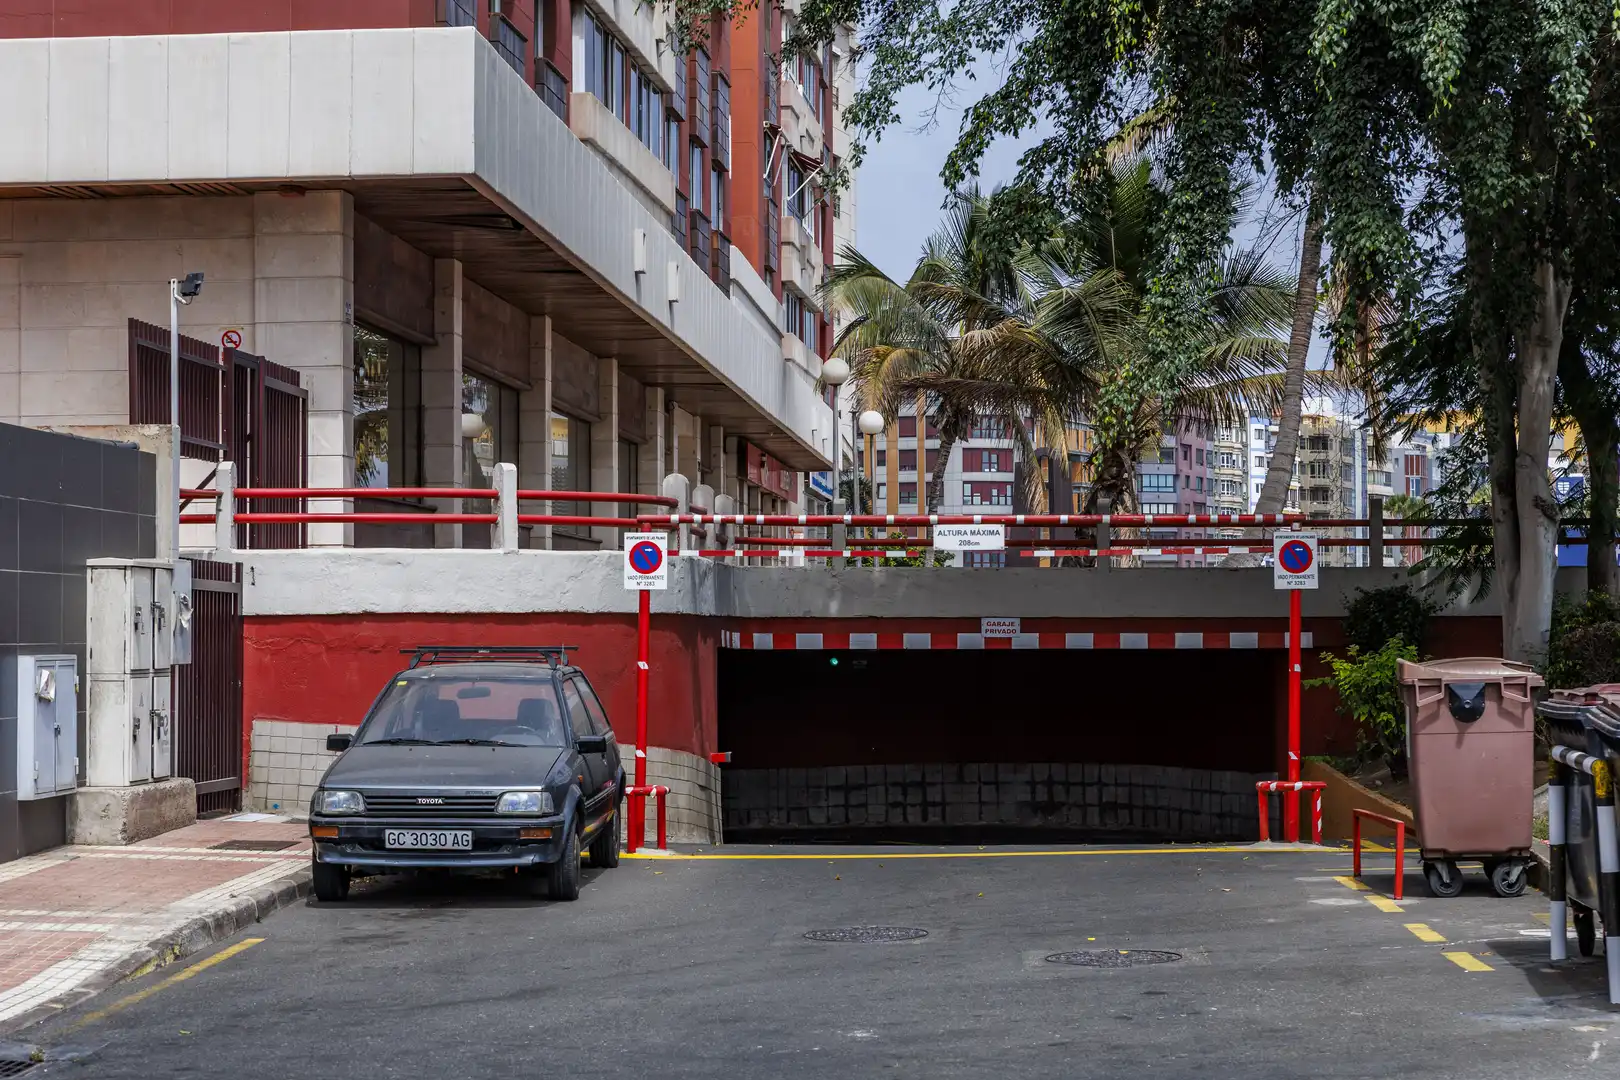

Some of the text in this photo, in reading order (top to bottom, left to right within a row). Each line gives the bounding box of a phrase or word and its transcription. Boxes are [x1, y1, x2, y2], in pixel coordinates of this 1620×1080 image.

[937, 528, 1000, 537] ALTURA MÁXIMA
[388, 832, 470, 847] GC 3030 AG
